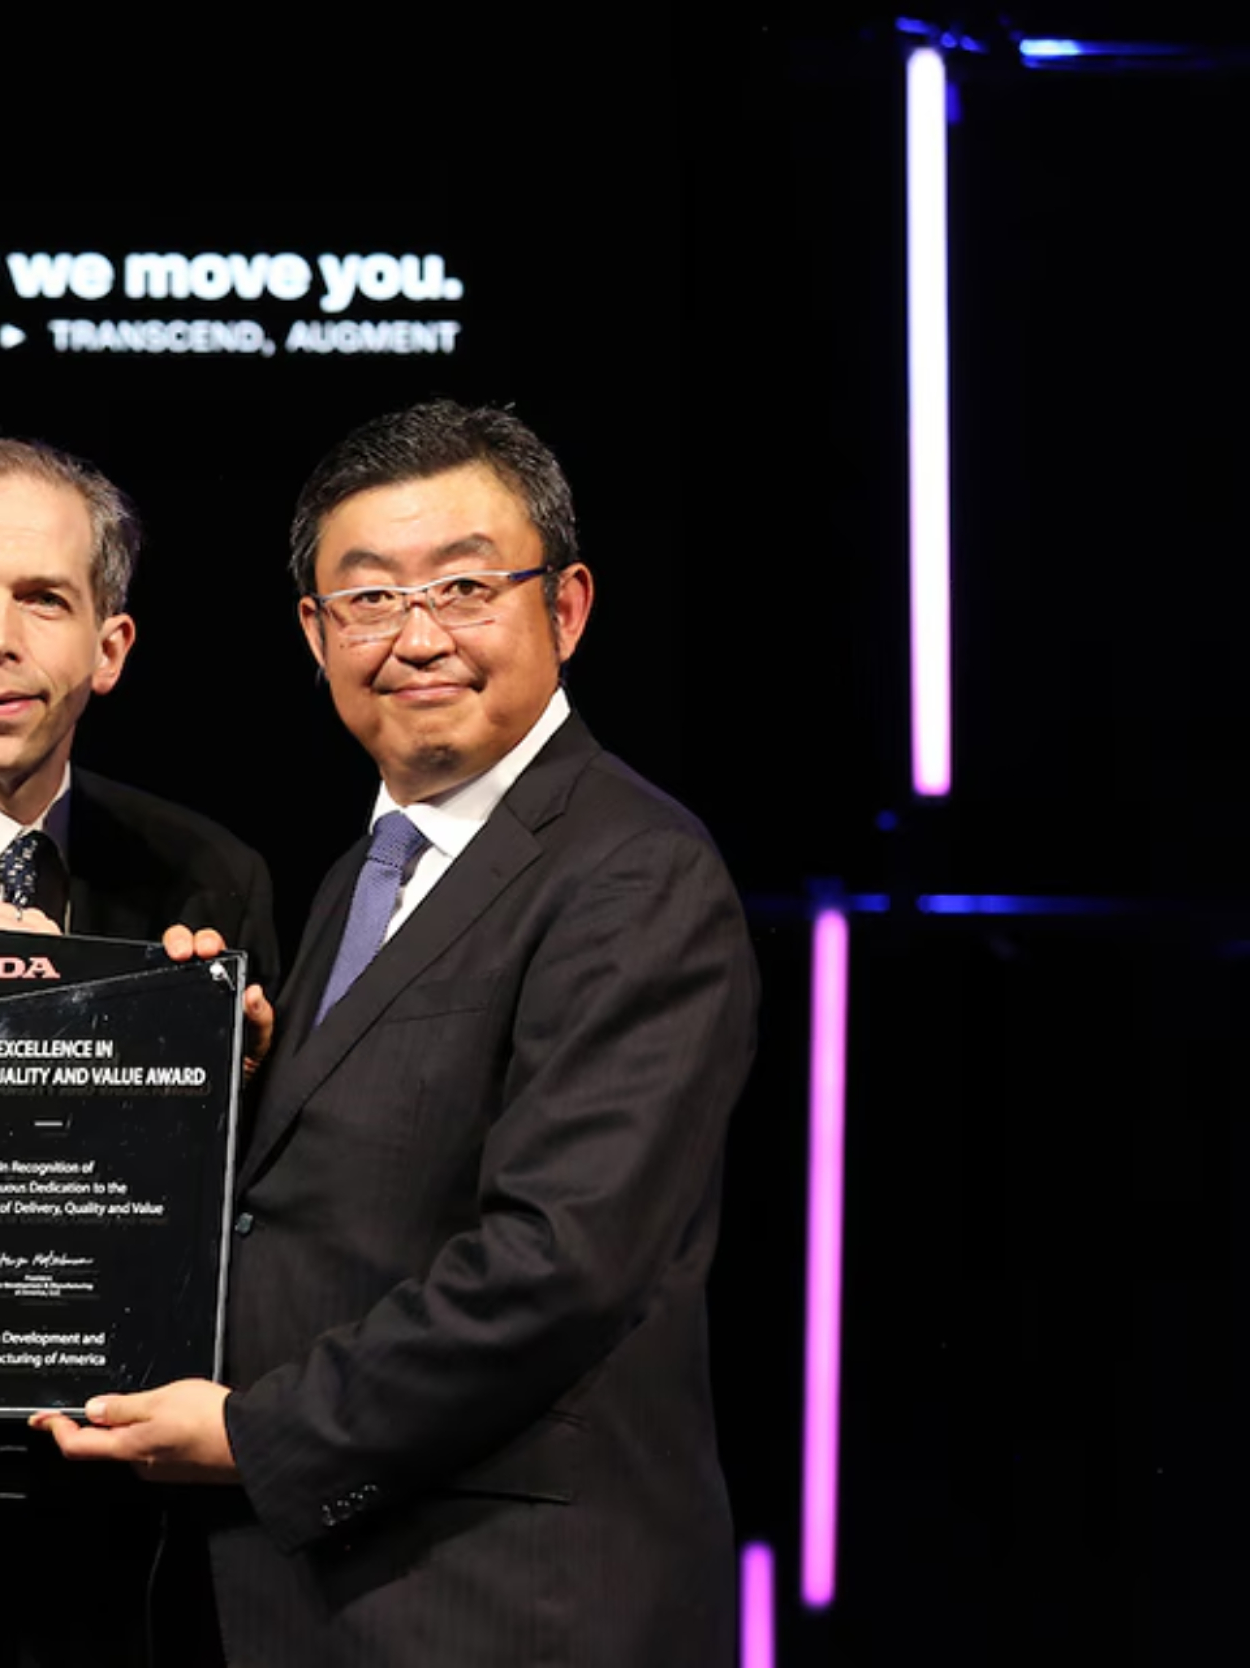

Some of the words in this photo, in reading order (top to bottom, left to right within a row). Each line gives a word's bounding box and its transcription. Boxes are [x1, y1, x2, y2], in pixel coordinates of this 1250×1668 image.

[6, 252, 115, 300] we
[124, 252, 312, 300] move
[317, 253, 463, 313] you.
[285, 320, 460, 353] AUGMENT
[95, 1040, 113, 1057] IN
[52, 1067, 89, 1085] AND
[92, 1068, 143, 1085] VALUE
[145, 1068, 205, 1085] AWARD
[11, 1161, 80, 1176] Recognition
[81, 1161, 95, 1173] of
[29, 1180, 90, 1193] Dedication
[93, 1183, 105, 1193] to
[108, 1182, 127, 1194] the
[0, 1201, 12, 1213] of
[14, 1201, 63, 1216] Delivery,
[64, 1201, 106, 1216] Quality
[107, 1202, 130, 1214] and
[131, 1202, 163, 1214] Value
[2, 1331, 80, 1346] Development
[82, 1333, 105, 1345] and
[44, 1351, 57, 1365] of
[58, 1353, 106, 1366] America
